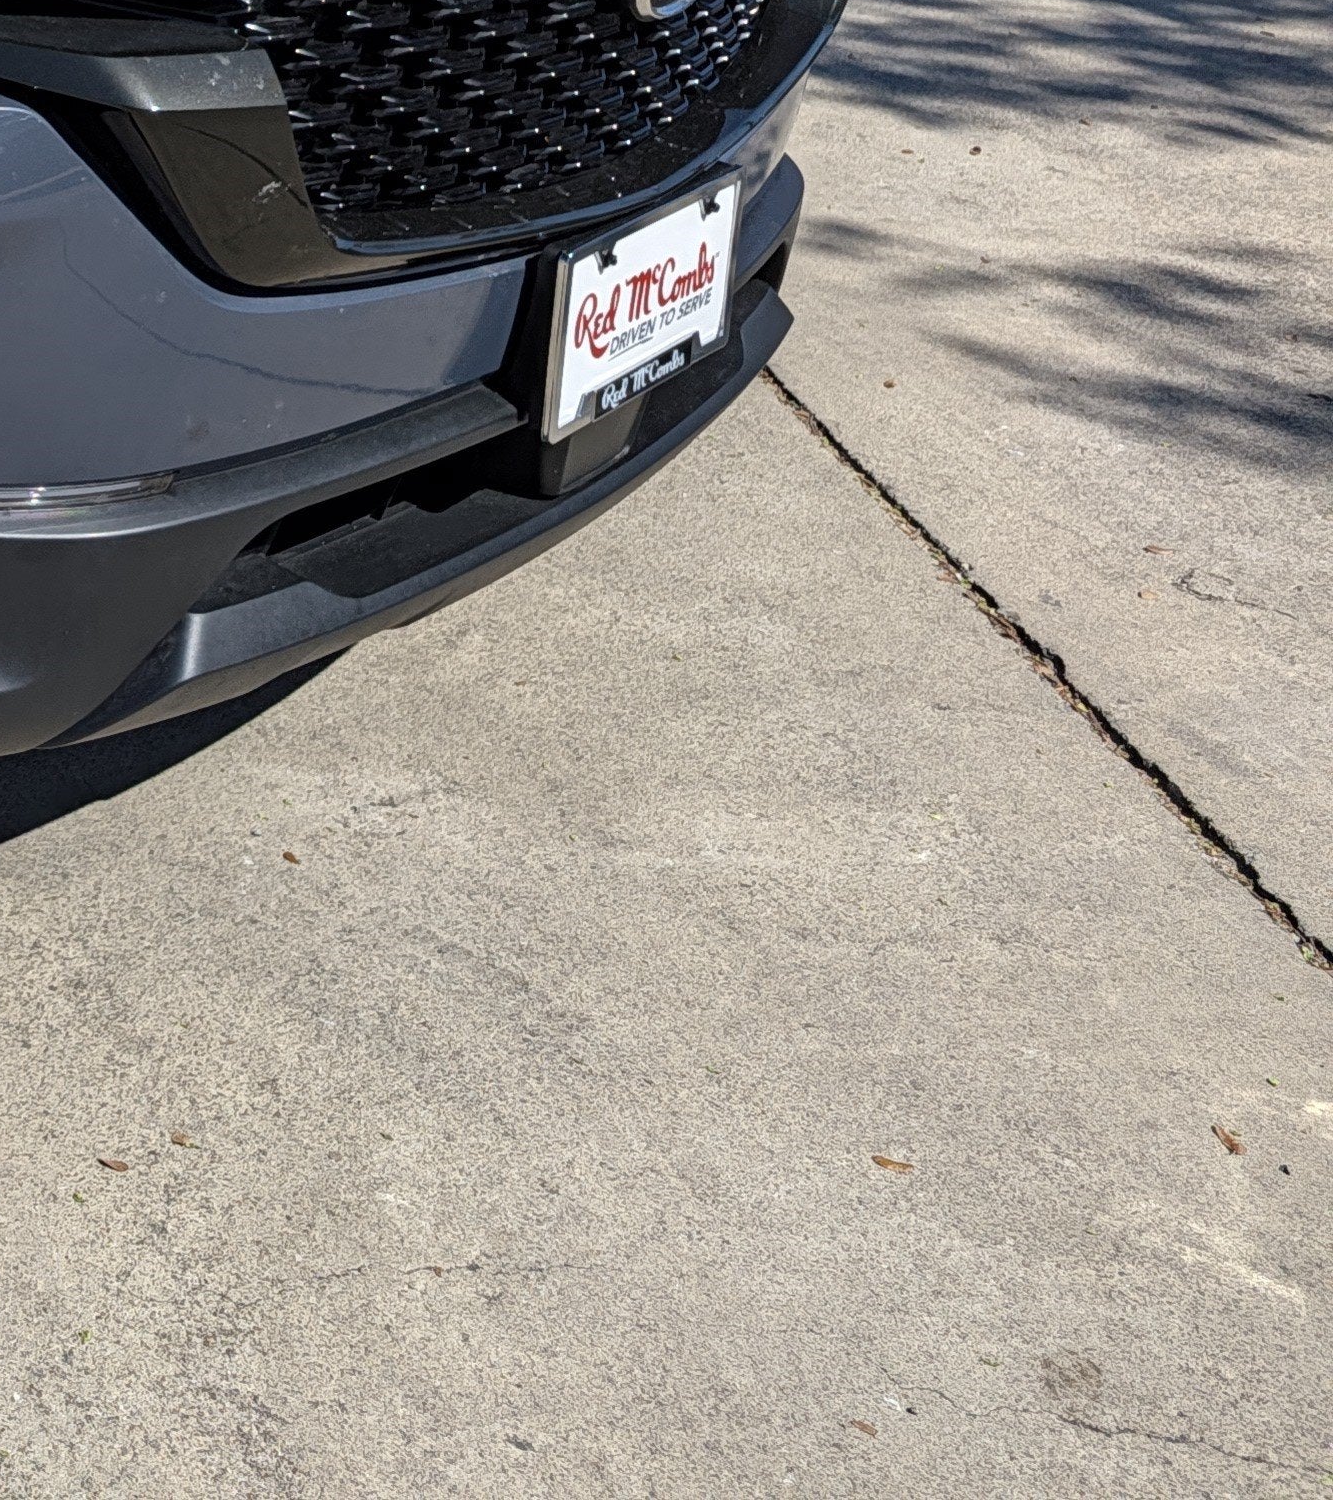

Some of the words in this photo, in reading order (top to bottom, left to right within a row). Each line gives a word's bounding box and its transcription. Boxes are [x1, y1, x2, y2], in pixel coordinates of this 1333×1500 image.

[574, 283, 621, 359] Red
[626, 241, 716, 323] McCombs
[608, 318, 656, 355] DRIVEN
[658, 307, 676, 330] TO
[677, 286, 713, 322] SERVE
[601, 378, 629, 411] Red
[630, 348, 686, 393] McCombs
